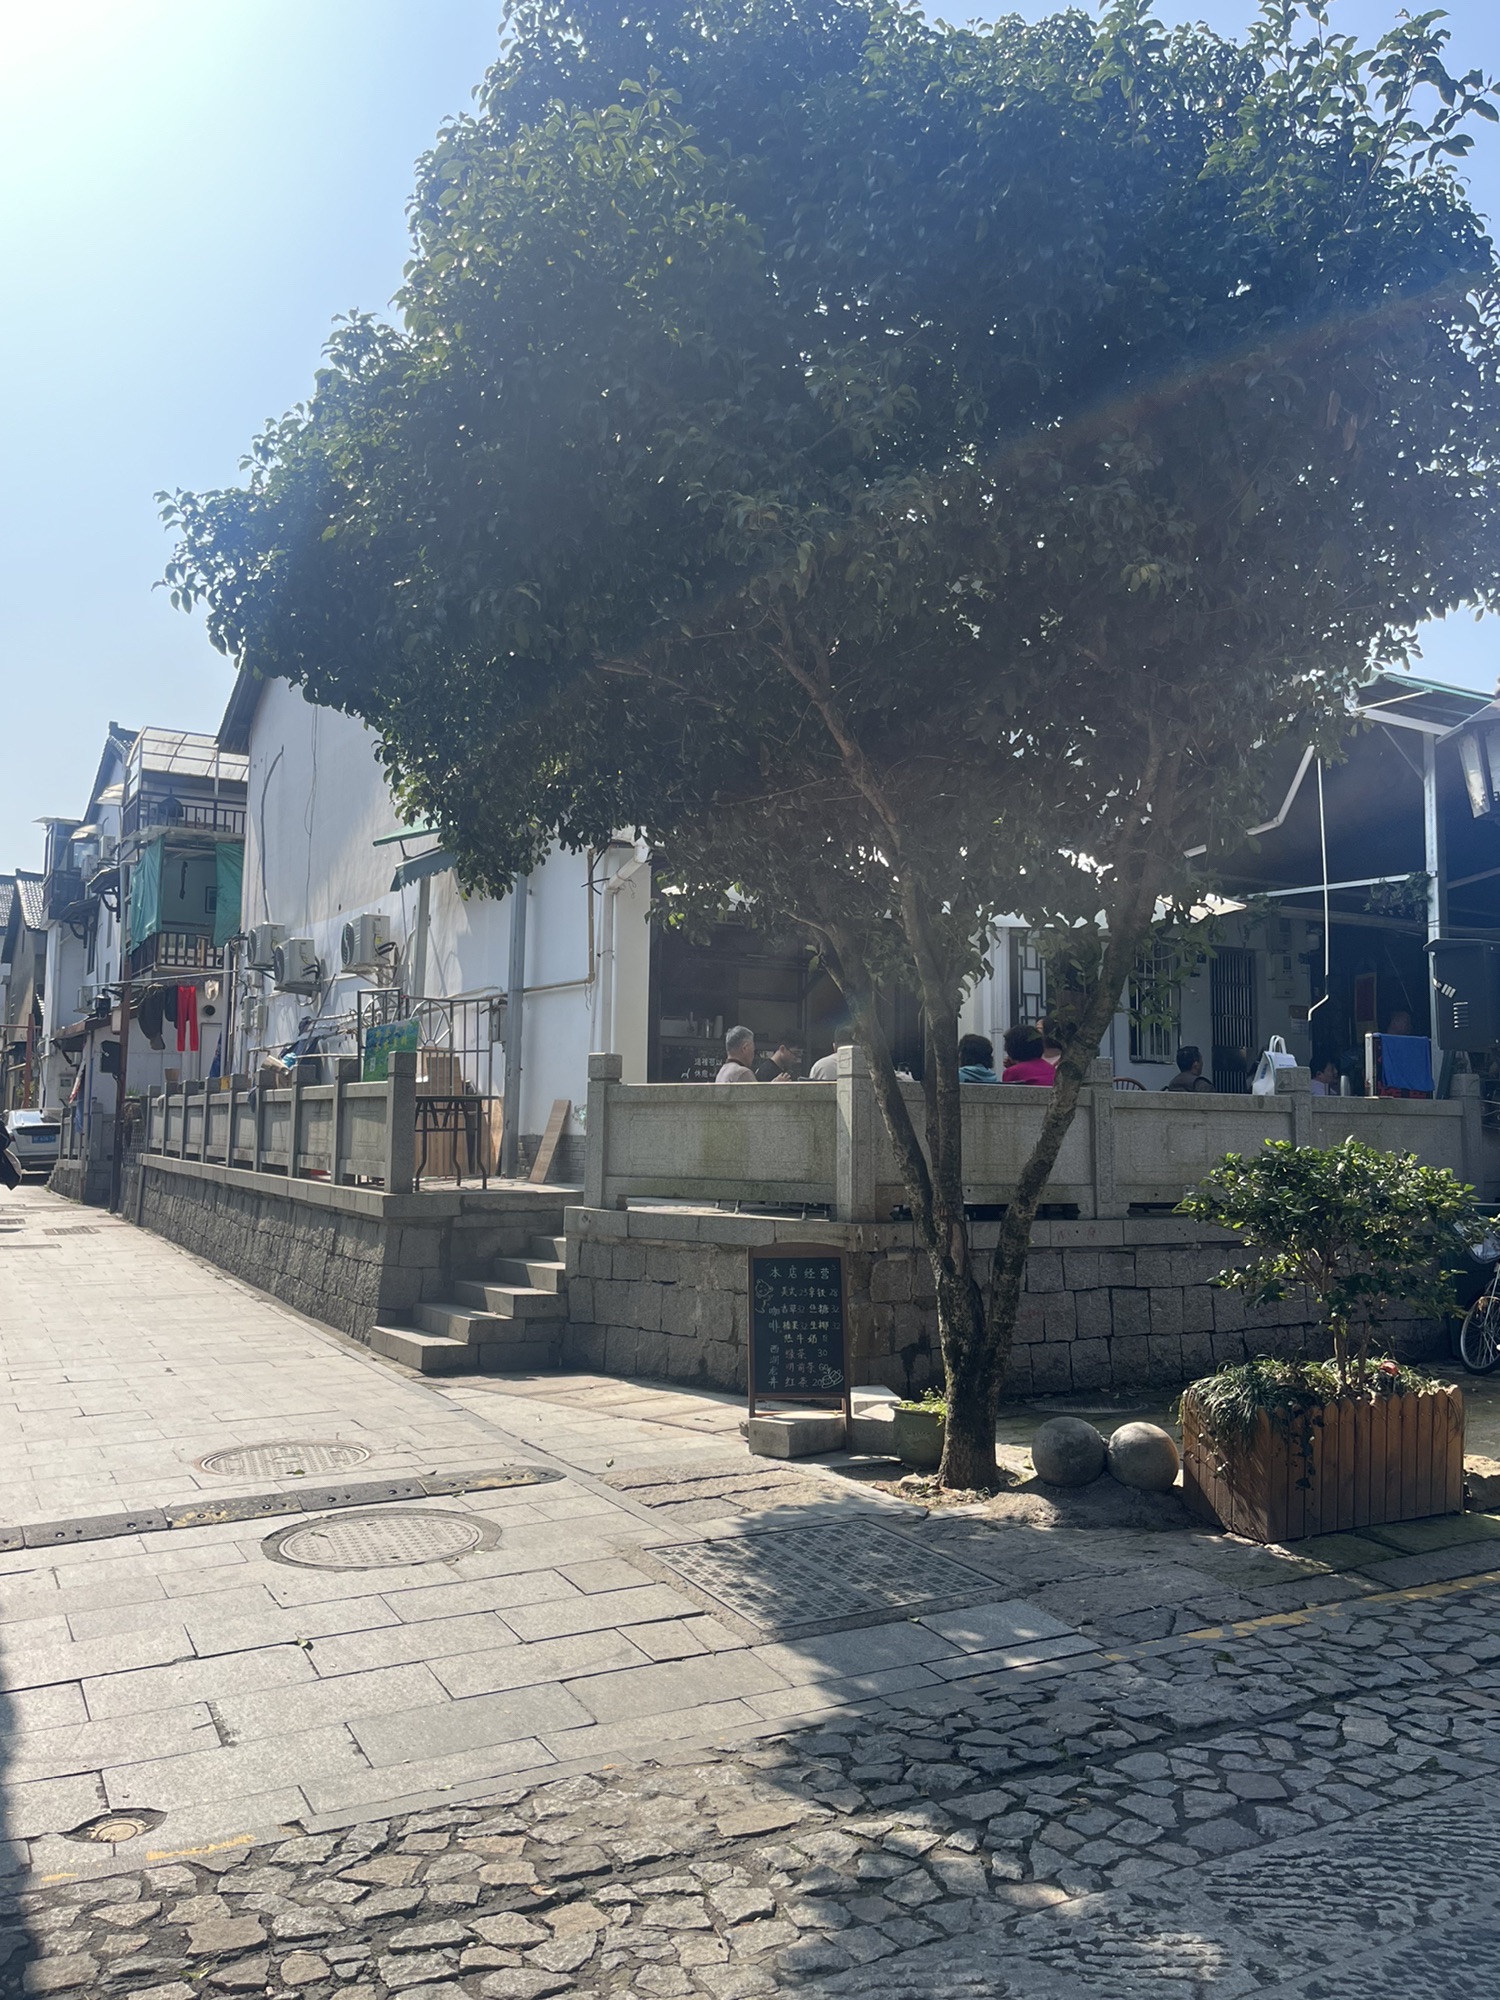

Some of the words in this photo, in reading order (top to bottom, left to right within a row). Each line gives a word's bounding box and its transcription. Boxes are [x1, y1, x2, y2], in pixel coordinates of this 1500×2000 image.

[769, 1264, 830, 1280] 本店经营
[781, 1285, 797, 1297] 美式
[808, 1286, 827, 1297] 拿铁
[810, 1320, 829, 1330] 生椰
[783, 1333, 818, 1344] 热牛奶
[785, 1348, 807, 1359] 绿茶
[817, 1348, 828, 1357] 30
[768, 1344, 780, 1390] 西湖龙井
[785, 1362, 816, 1373] 明前茶
[818, 1363, 829, 1371] 60
[784, 1376, 809, 1388] 红茶
[812, 1378, 823, 1387] 20
